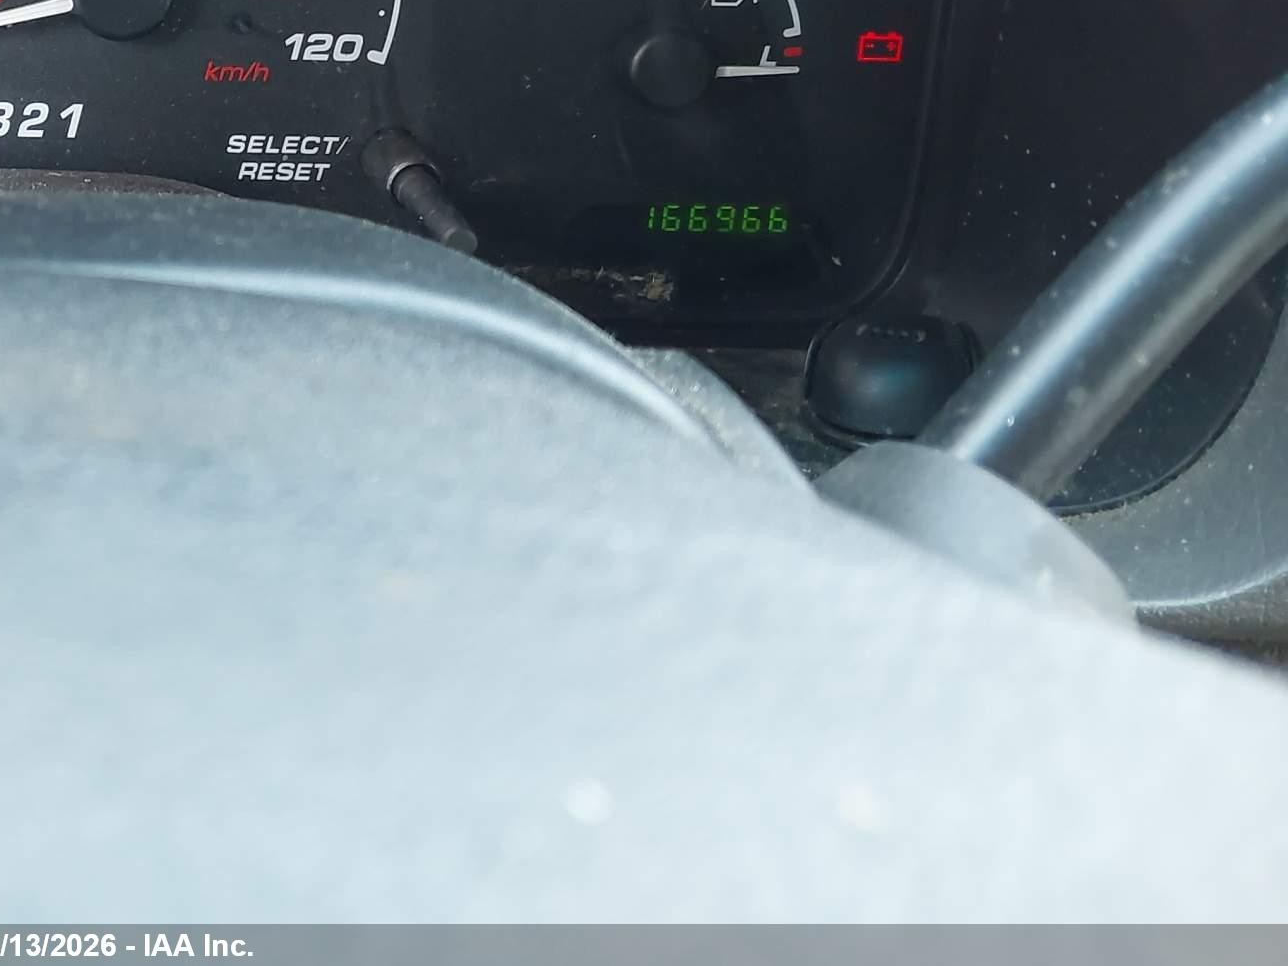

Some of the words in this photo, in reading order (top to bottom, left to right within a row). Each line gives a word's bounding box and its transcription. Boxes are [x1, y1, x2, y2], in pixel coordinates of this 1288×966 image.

[284, 34, 364, 61] 120
[760, 45, 777, 66] L
[204, 61, 270, 81] km/h
[227, 135, 350, 155] SELECT/
[238, 162, 331, 181] RESET
[647, 204, 788, 233] 166966
